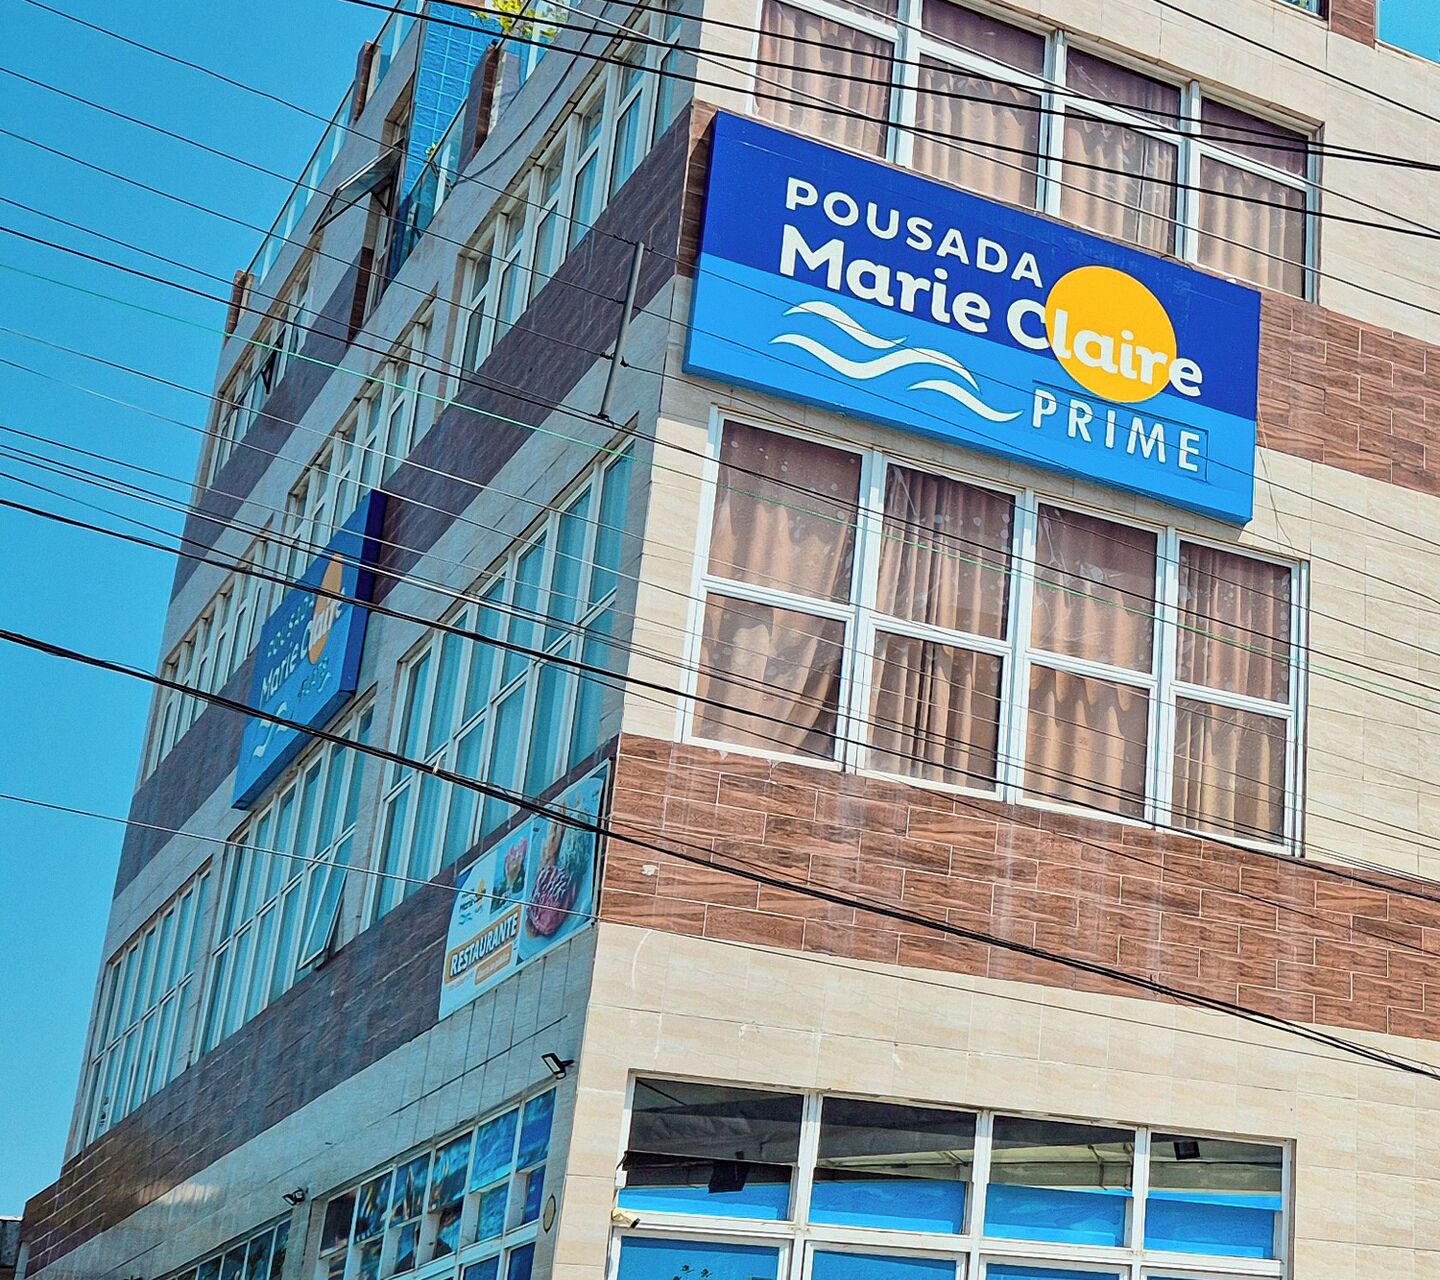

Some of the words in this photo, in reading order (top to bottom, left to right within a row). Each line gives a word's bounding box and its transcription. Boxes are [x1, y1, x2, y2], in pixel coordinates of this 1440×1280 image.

[786, 176, 1044, 289] POUSADA
[779, 224, 991, 334] Marie
[1006, 297, 1204, 397] Claire
[1032, 388, 1202, 473] PRIME
[450, 912, 518, 976] RESTAURANTE
